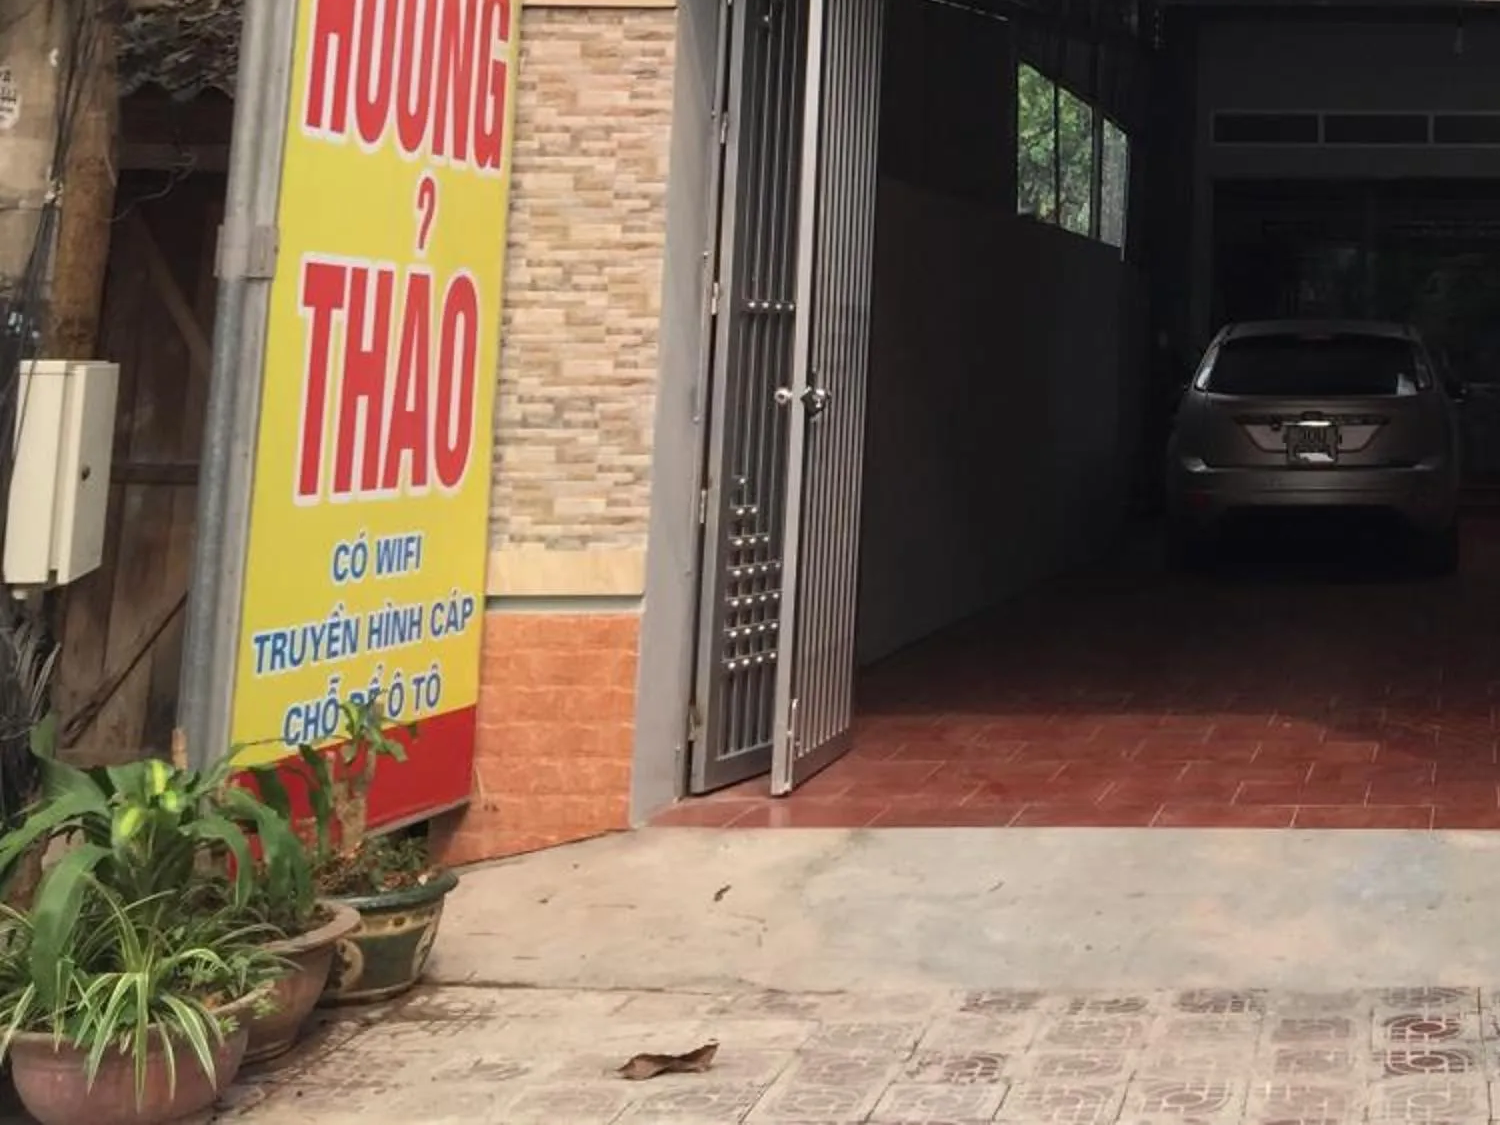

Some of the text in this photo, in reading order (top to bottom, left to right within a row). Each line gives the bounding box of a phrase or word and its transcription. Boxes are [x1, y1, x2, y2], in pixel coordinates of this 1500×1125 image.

[297, 176, 479, 498] THẢO
[332, 530, 423, 582] CÓ WIFI
[253, 602, 361, 674] TRUYỀN
[366, 602, 424, 650] HÌNH
[283, 676, 341, 746] CHỖ
[387, 671, 405, 718] Ô
[412, 662, 442, 712] TÔ
